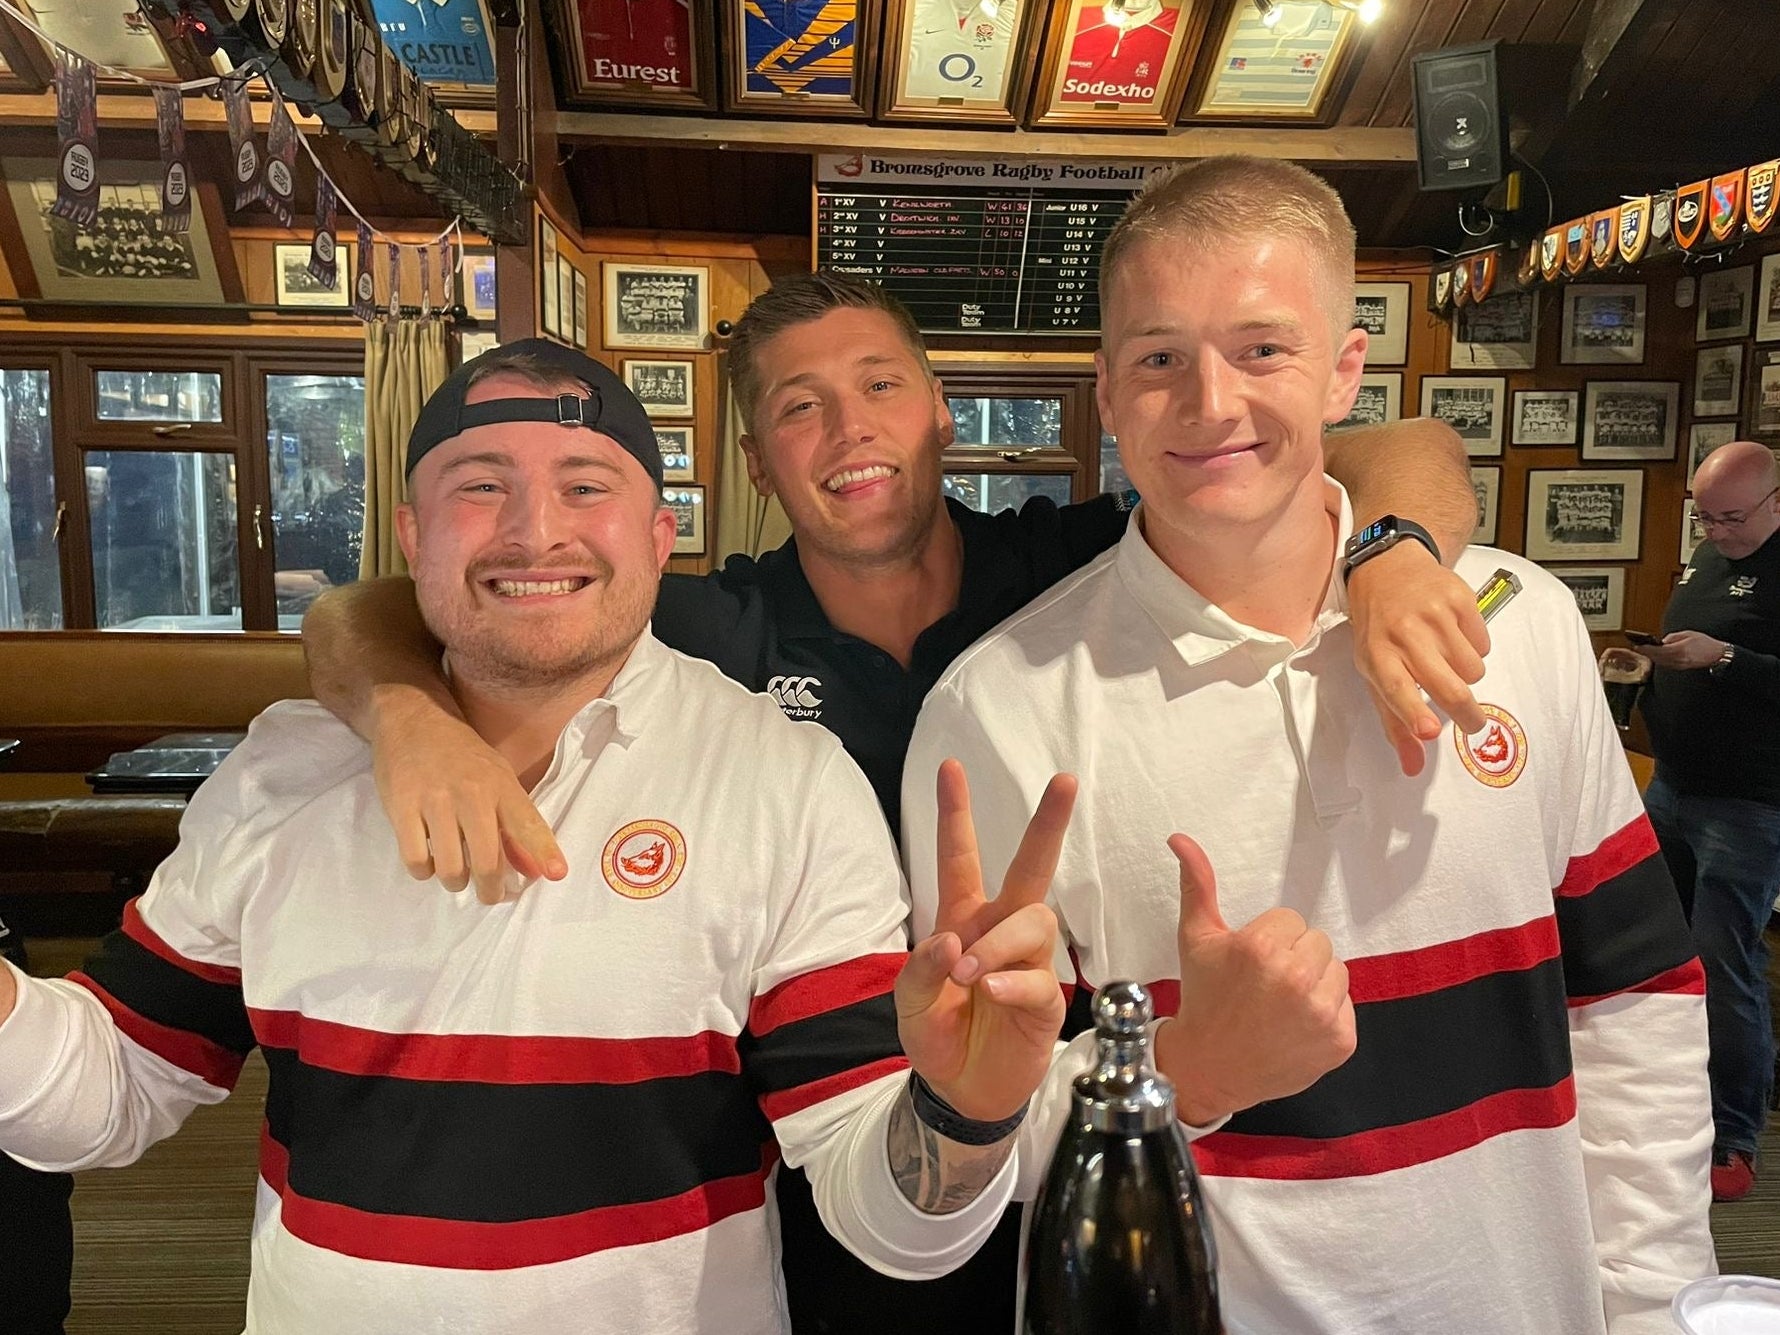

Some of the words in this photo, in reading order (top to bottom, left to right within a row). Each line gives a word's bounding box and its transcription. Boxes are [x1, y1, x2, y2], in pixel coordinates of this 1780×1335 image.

[401, 43, 476, 66] CASTLE
[593, 59, 680, 84] Eurest
[939, 53, 983, 88] O2
[1063, 79, 1155, 98] Sodexho
[241, 158, 254, 174] 2023
[870, 159, 985, 178] Bromsgrove
[992, 163, 1053, 180] Rugby
[1060, 165, 1144, 180] Football
[71, 163, 89, 182] 2023
[273, 171, 288, 193] 2023
[171, 183, 183, 195] 2023
[819, 198, 828, 206] A
[879, 199, 887, 207] V
[988, 202, 998, 210] W
[879, 213, 887, 221] V
[985, 216, 996, 224] W
[1001, 216, 1011, 225] 13
[1015, 217, 1025, 225] 10
[1068, 217, 1086, 225] U15
[878, 227, 885, 235] V
[1000, 229, 1009, 237] 10
[876, 253, 884, 261] V
[832, 266, 873, 274] Crusaders
[980, 268, 991, 276] W
[994, 267, 1005, 275] 50
[961, 316, 981, 324] Duty
[783, 707, 822, 719] erbury
